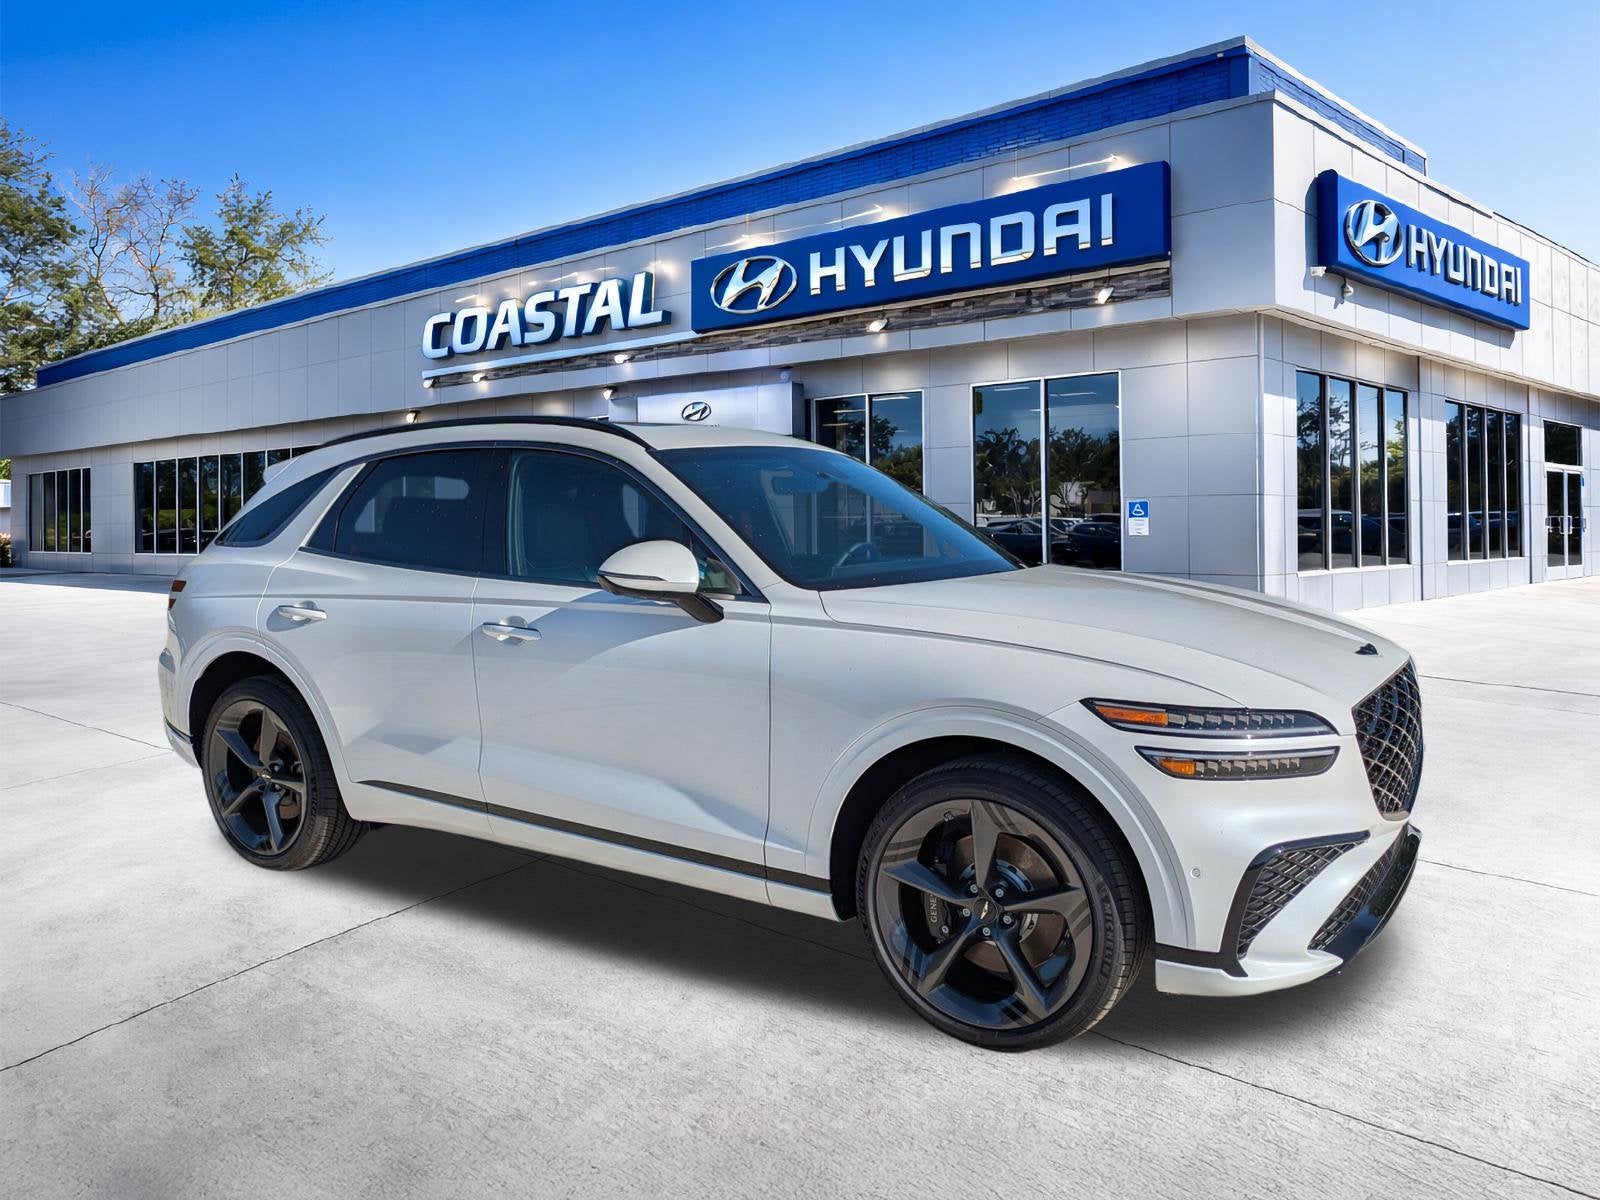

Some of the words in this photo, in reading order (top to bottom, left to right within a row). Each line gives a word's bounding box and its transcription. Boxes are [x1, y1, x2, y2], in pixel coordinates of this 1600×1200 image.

[809, 193, 1113, 295] HYUNDAI
[1407, 224, 1522, 306] HYUNDAI
[422, 271, 669, 359] COASTAL
[929, 894, 938, 923] GENE
